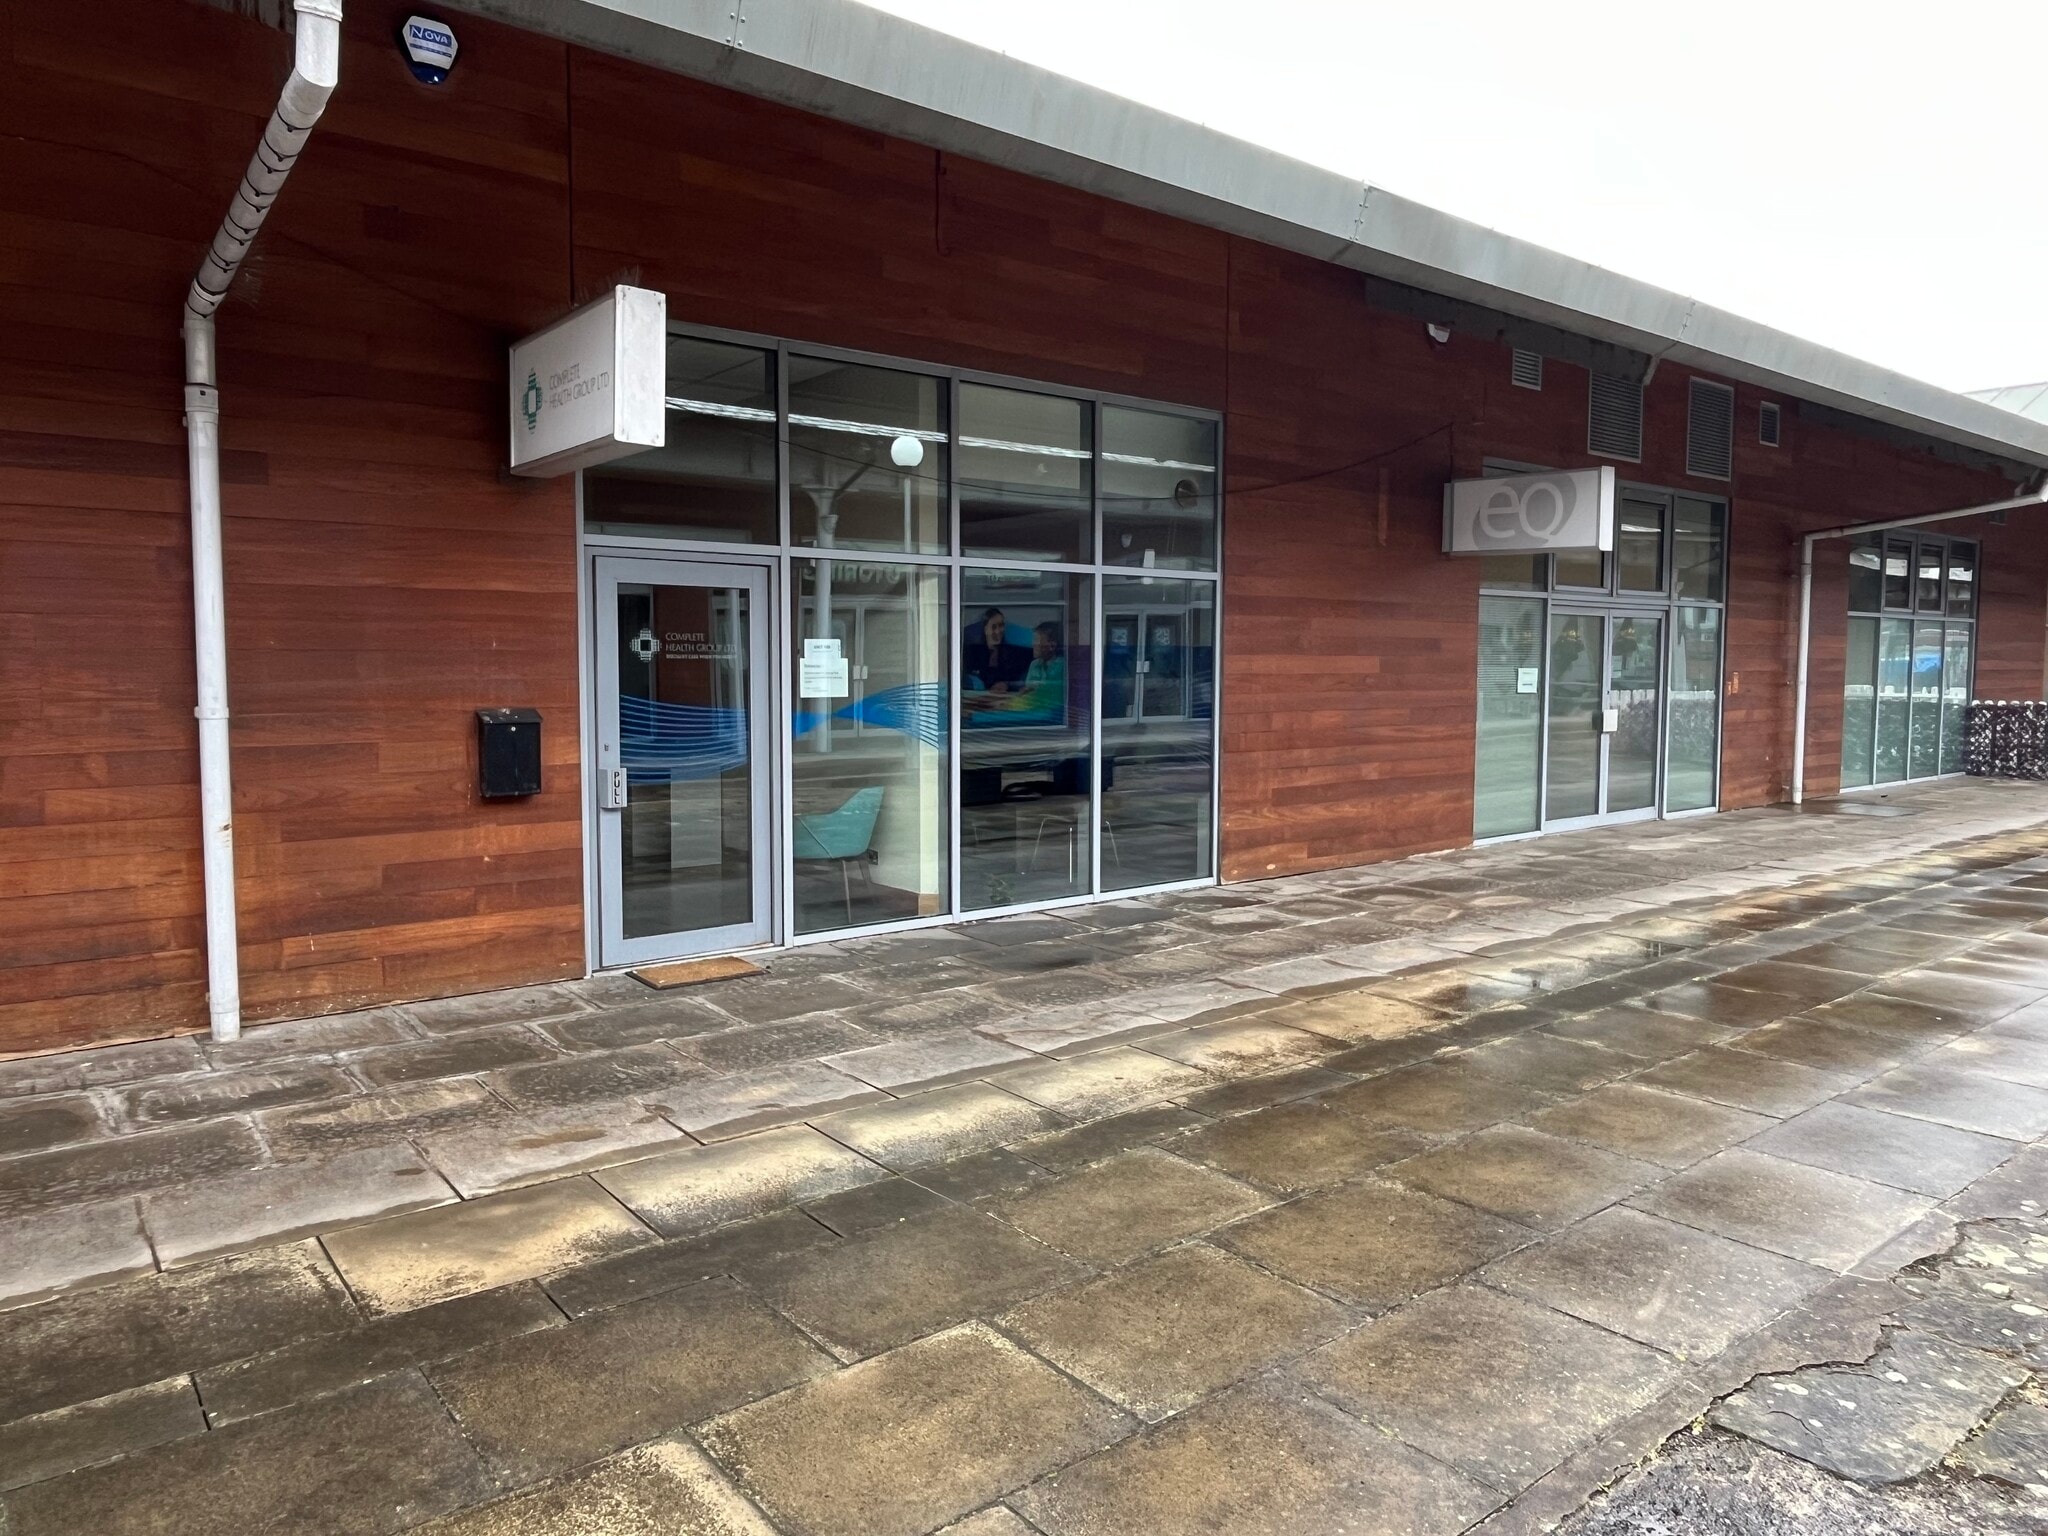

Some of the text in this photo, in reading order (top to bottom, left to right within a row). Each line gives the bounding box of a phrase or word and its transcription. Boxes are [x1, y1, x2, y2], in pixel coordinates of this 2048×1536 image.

[410, 26, 449, 44] NOVA
[549, 363, 580, 390] COMPLETE
[573, 377, 596, 400] GROUP
[597, 371, 610, 391] LTD
[665, 632, 705, 642] COMPLETE
[665, 643, 737, 653] HEALTH GROUP LTD
[613, 771, 621, 805] PULL
